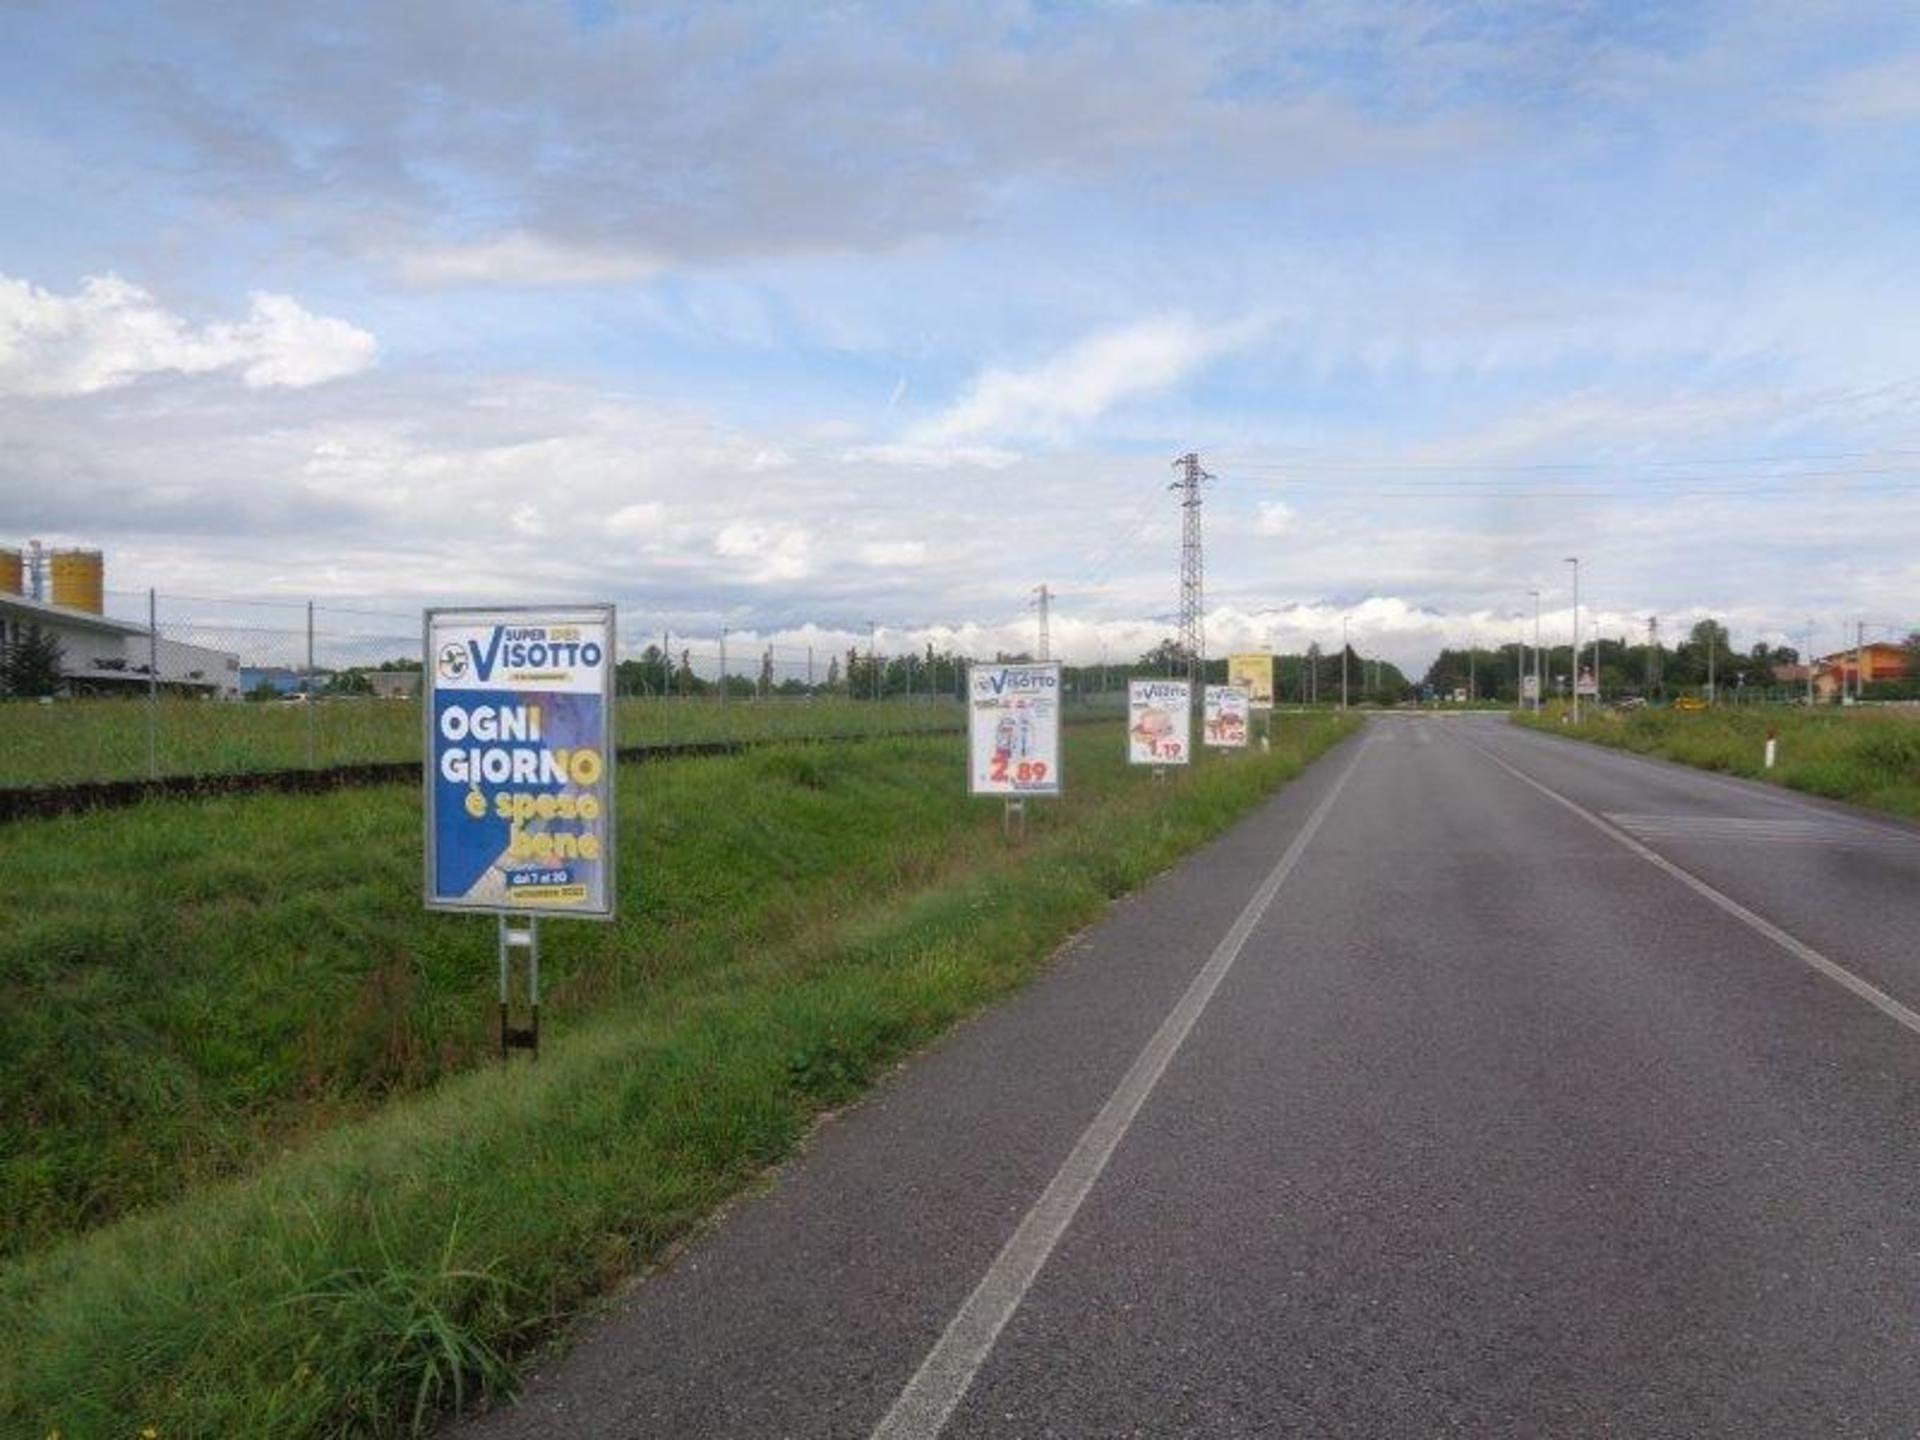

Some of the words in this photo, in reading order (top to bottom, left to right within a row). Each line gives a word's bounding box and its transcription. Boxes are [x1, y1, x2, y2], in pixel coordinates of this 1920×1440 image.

[467, 624, 602, 682] VISOTTO
[505, 628, 546, 641] SUPER
[440, 705, 542, 742] OGNI
[440, 747, 602, 785] GIORNO
